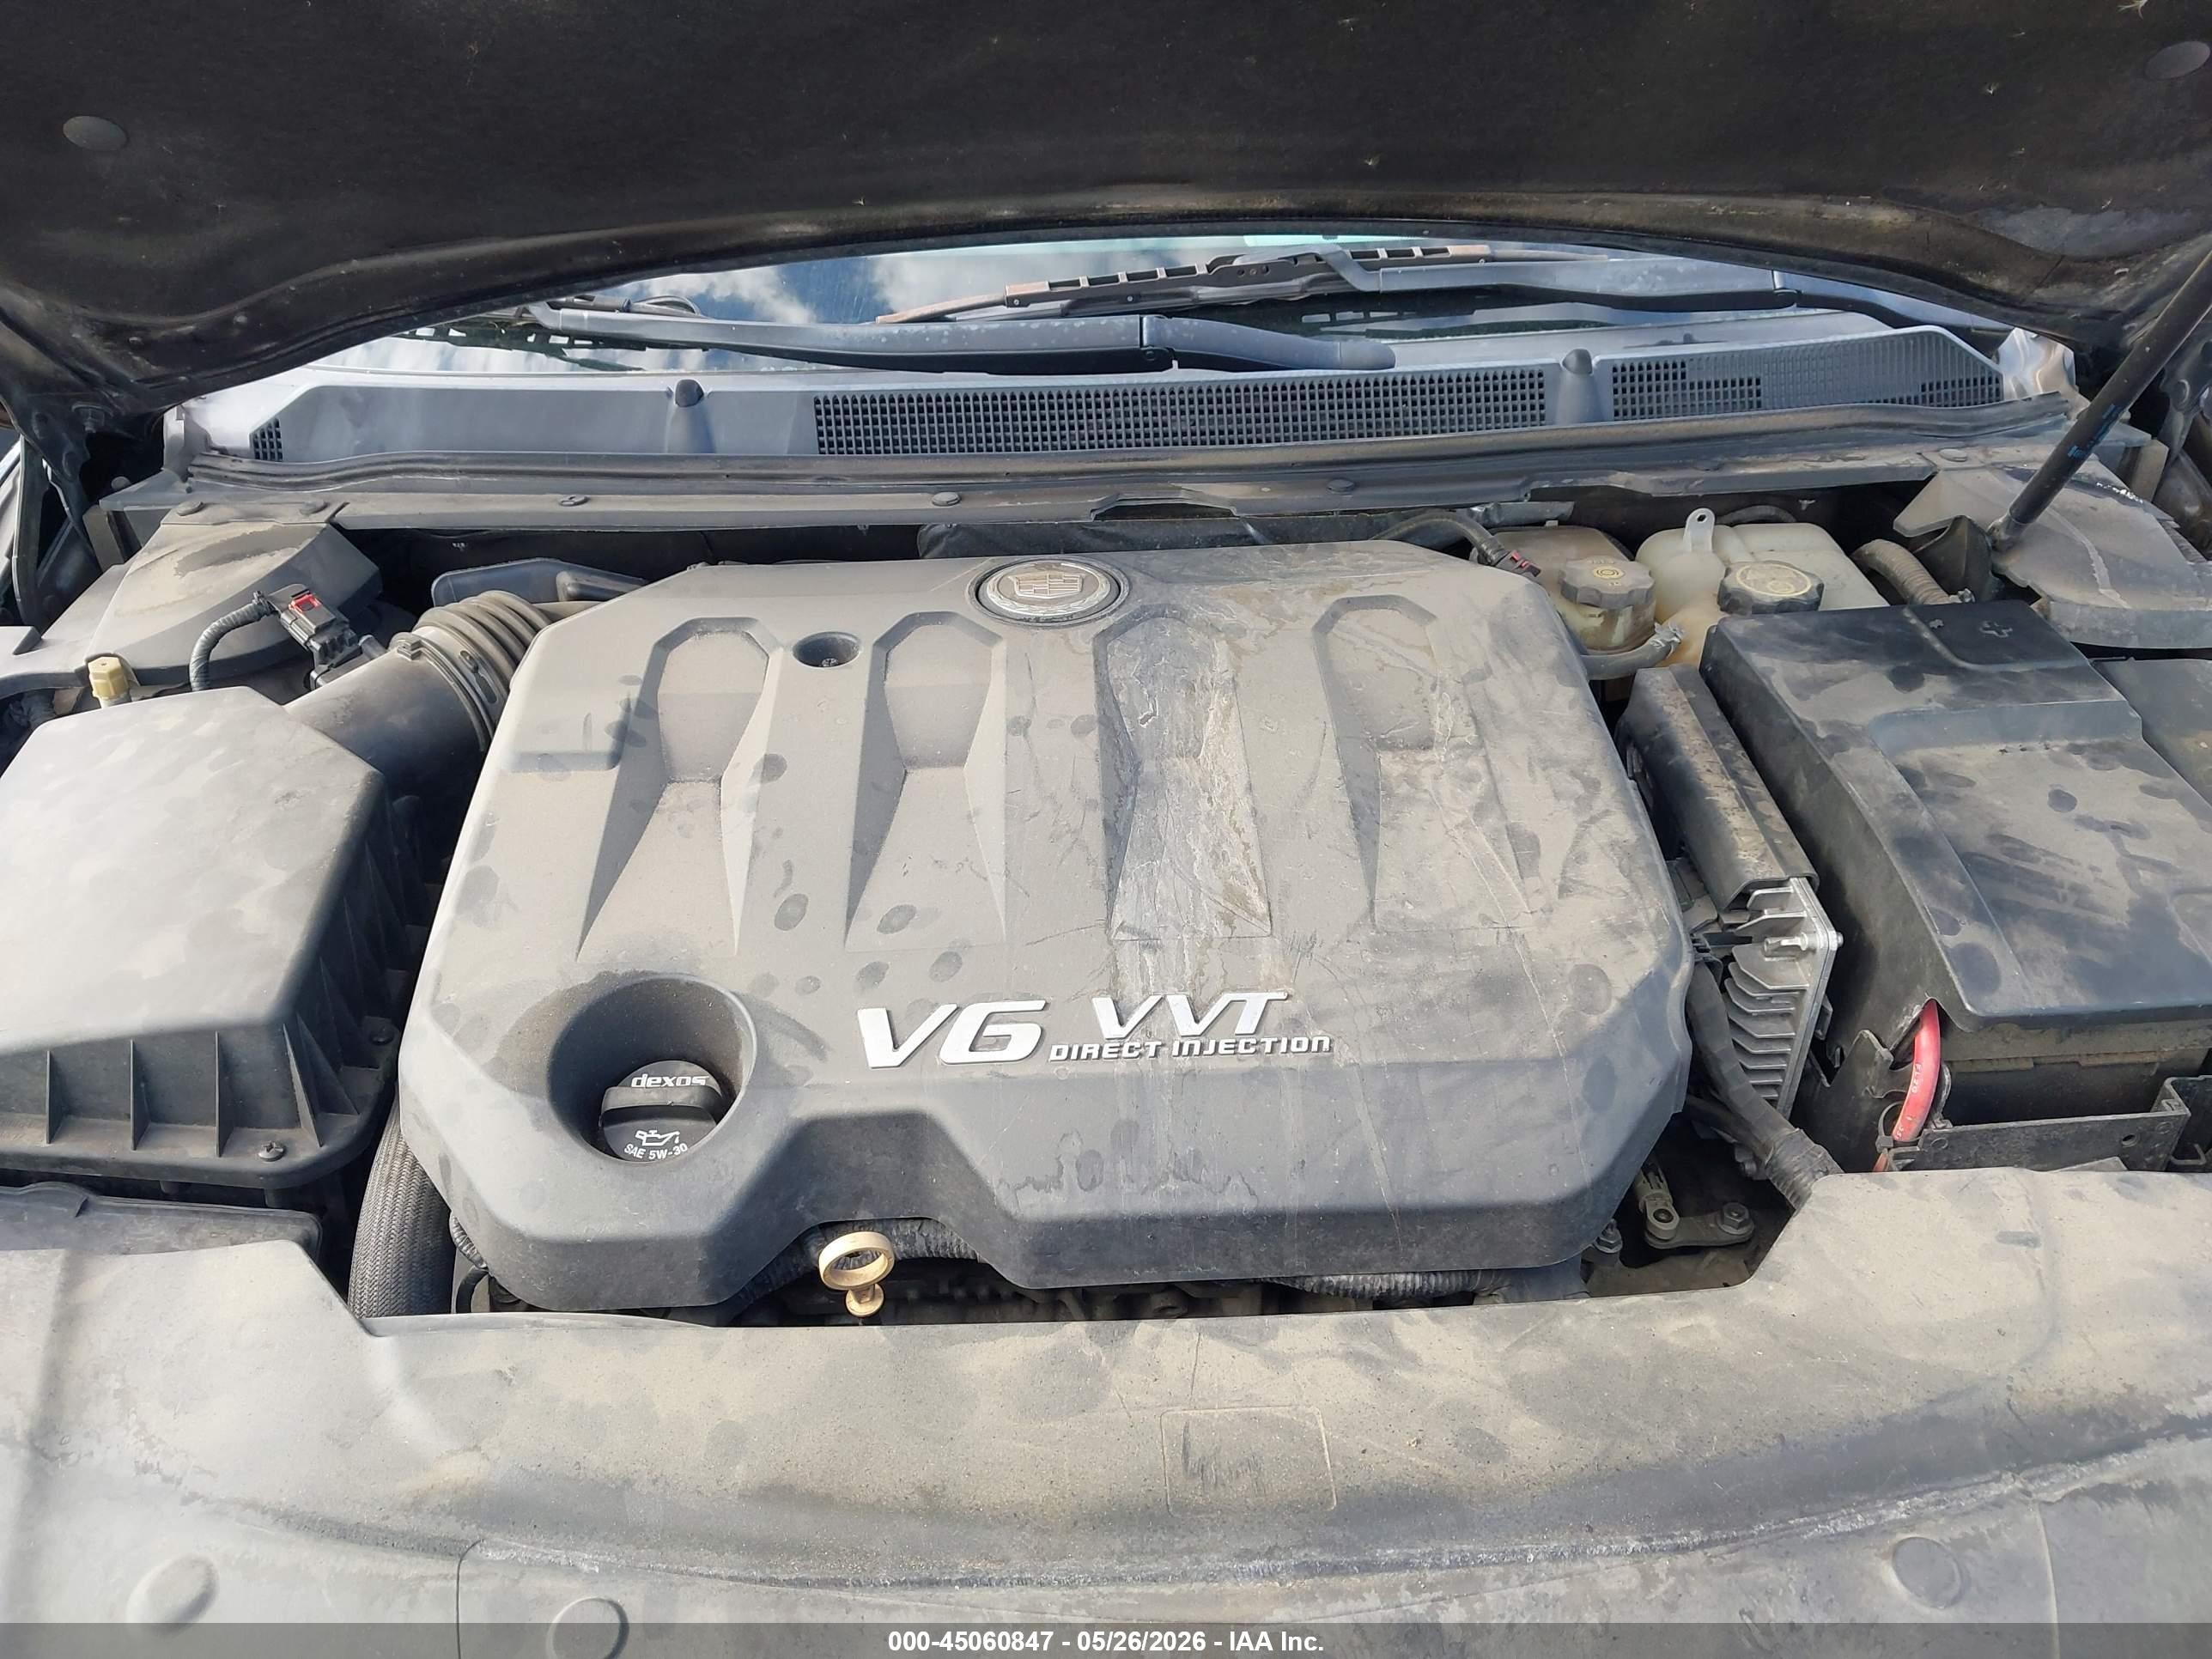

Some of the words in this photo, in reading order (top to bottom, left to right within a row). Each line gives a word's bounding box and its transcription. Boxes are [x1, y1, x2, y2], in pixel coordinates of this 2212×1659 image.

[857, 1000, 1047, 1068] V6
[1092, 991, 1288, 1040] VVT
[1049, 1041, 1162, 1061] DIRECT
[1171, 1036, 1333, 1057] INJECTION
[630, 1073, 709, 1088] dexos
[623, 1143, 647, 1159] SAE
[648, 1143, 688, 1159] 5W-30
